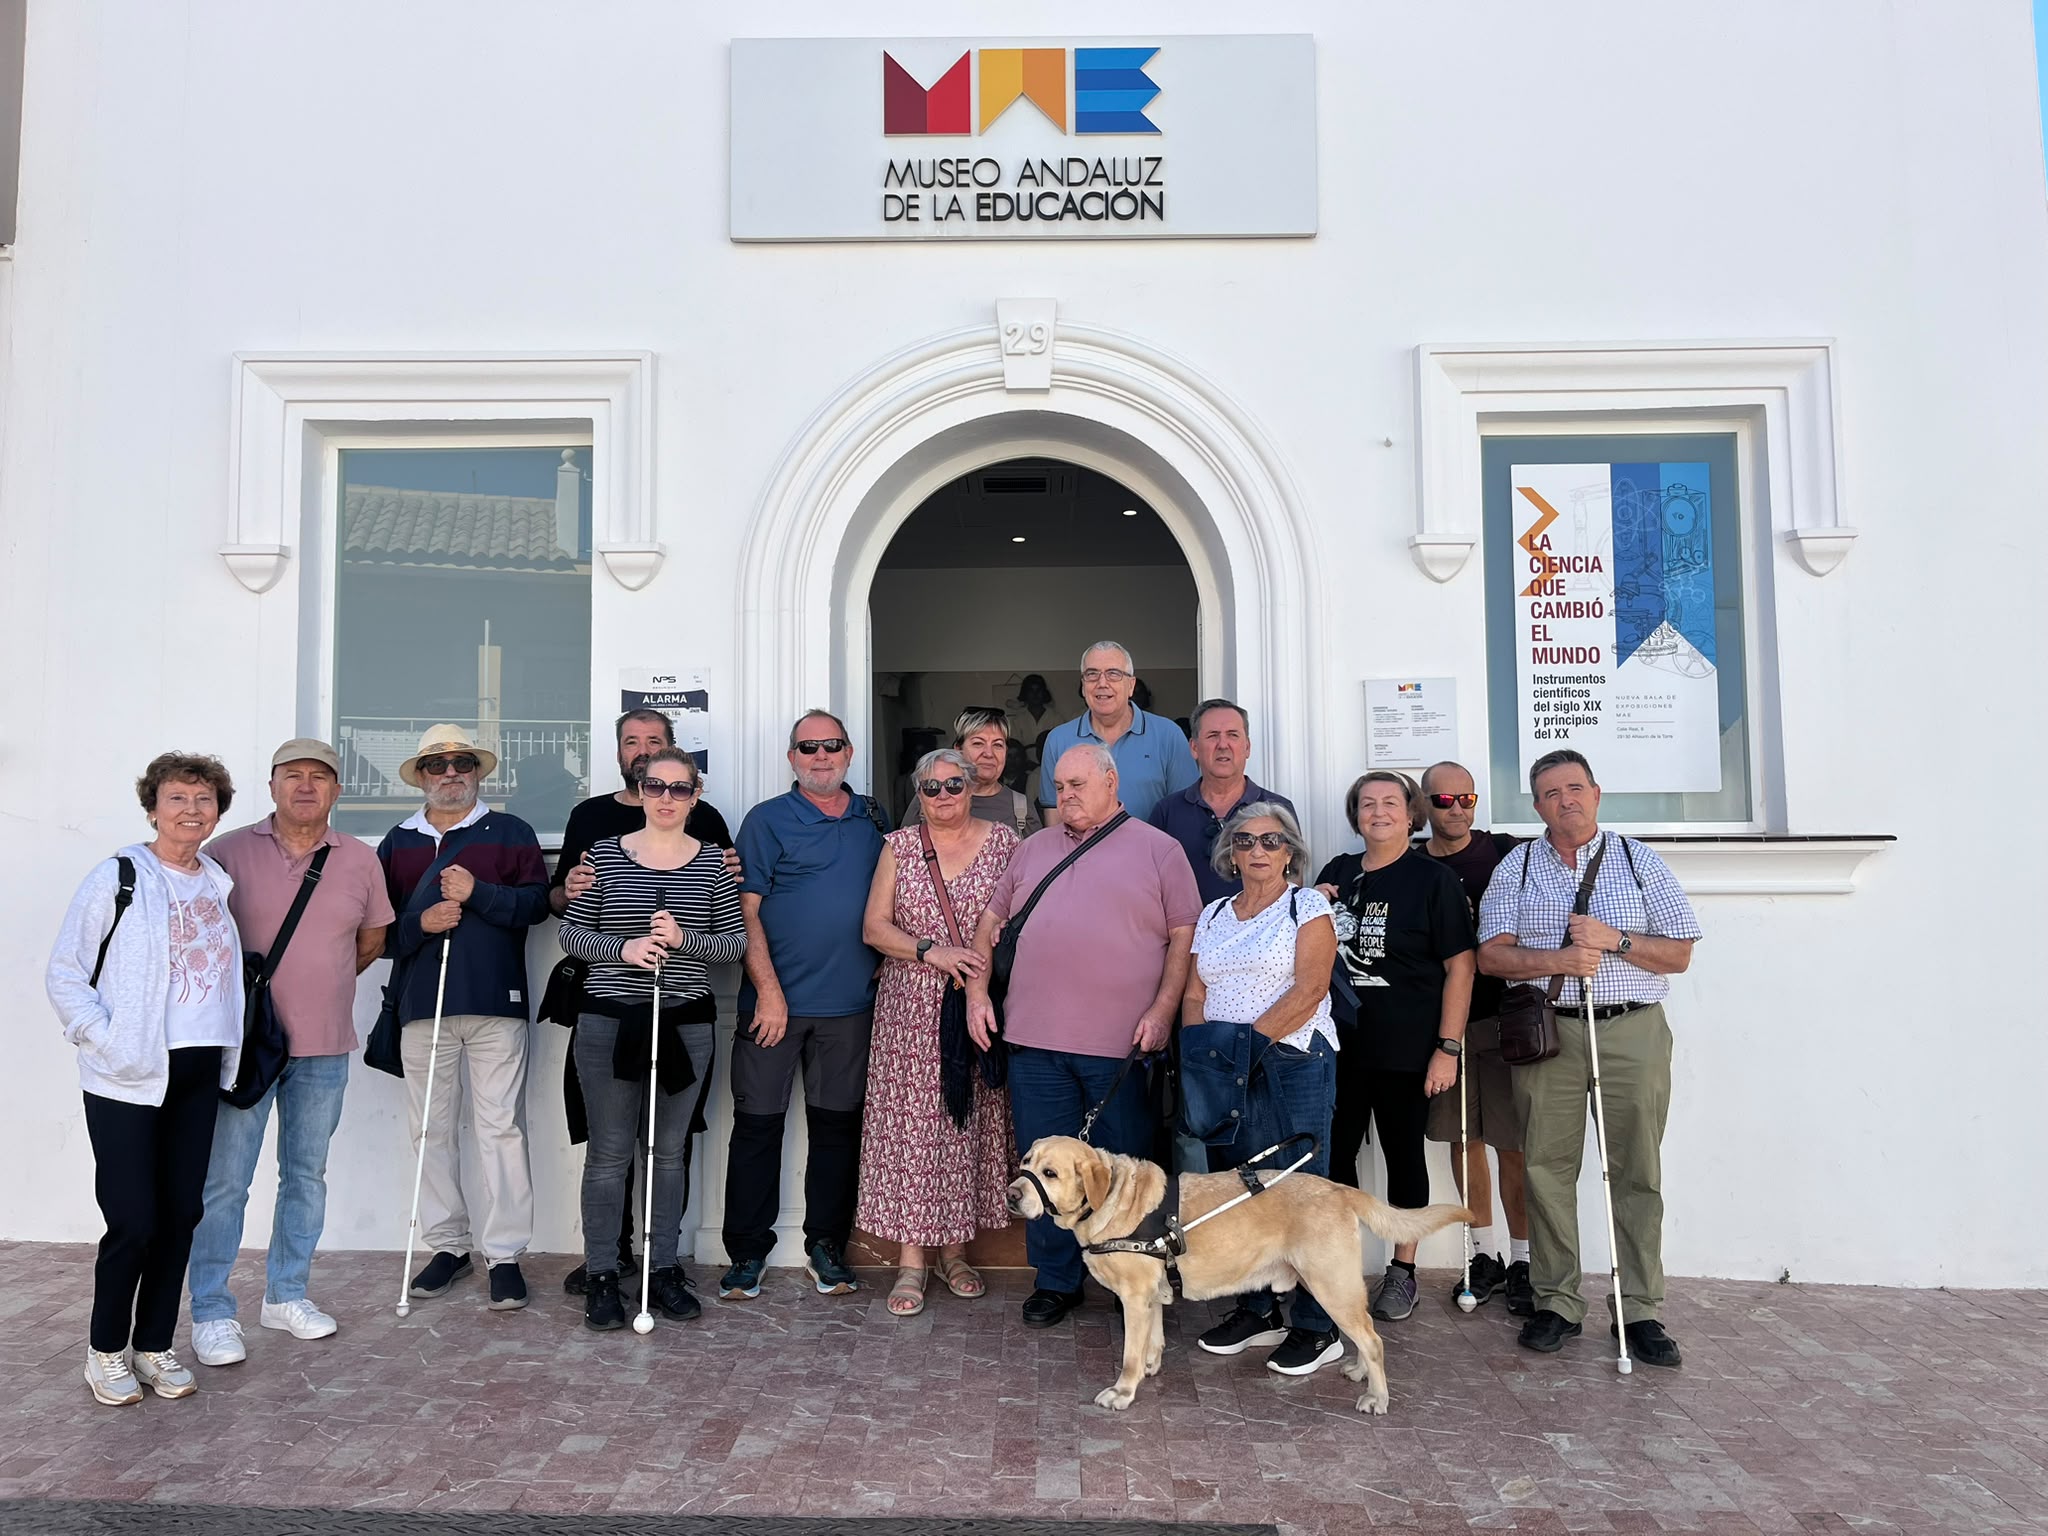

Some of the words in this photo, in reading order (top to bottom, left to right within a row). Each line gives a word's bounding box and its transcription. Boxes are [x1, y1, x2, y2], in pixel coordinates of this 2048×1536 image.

[884, 157, 1001, 188] MUSEO
[1017, 156, 1163, 187] ANDALUZ
[884, 193, 919, 221] DE
[933, 193, 965, 221] LA
[976, 187, 1164, 221] EDUCACIÓN
[1005, 322, 1049, 356] 29
[1529, 534, 1552, 551] LA
[1529, 556, 1603, 574] CIENCIA
[1530, 579, 1566, 597] QUE
[1531, 597, 1604, 619] CAMBIÓ
[1532, 625, 1553, 641] EL
[1532, 646, 1601, 664] MUNDO
[653, 676, 676, 684] NPS
[1533, 673, 1606, 684] Instrumentos
[642, 694, 687, 704] ALARMA
[1533, 687, 1590, 698] científicos
[1534, 701, 1550, 712] del
[1553, 701, 1580, 714] siglo
[1583, 700, 1602, 711] XIX
[1534, 717, 1540, 728] y
[1543, 714, 1598, 728] principios
[1534, 728, 1551, 739] del
[1554, 728, 1569, 739] XX
[1365, 902, 1389, 916] YOGA
[1361, 916, 1387, 926] BECAUSE
[1359, 925, 1386, 936] PUNCHING
[1359, 936, 1385, 948] PEOPLE
[1363, 947, 1386, 958] WRONG
